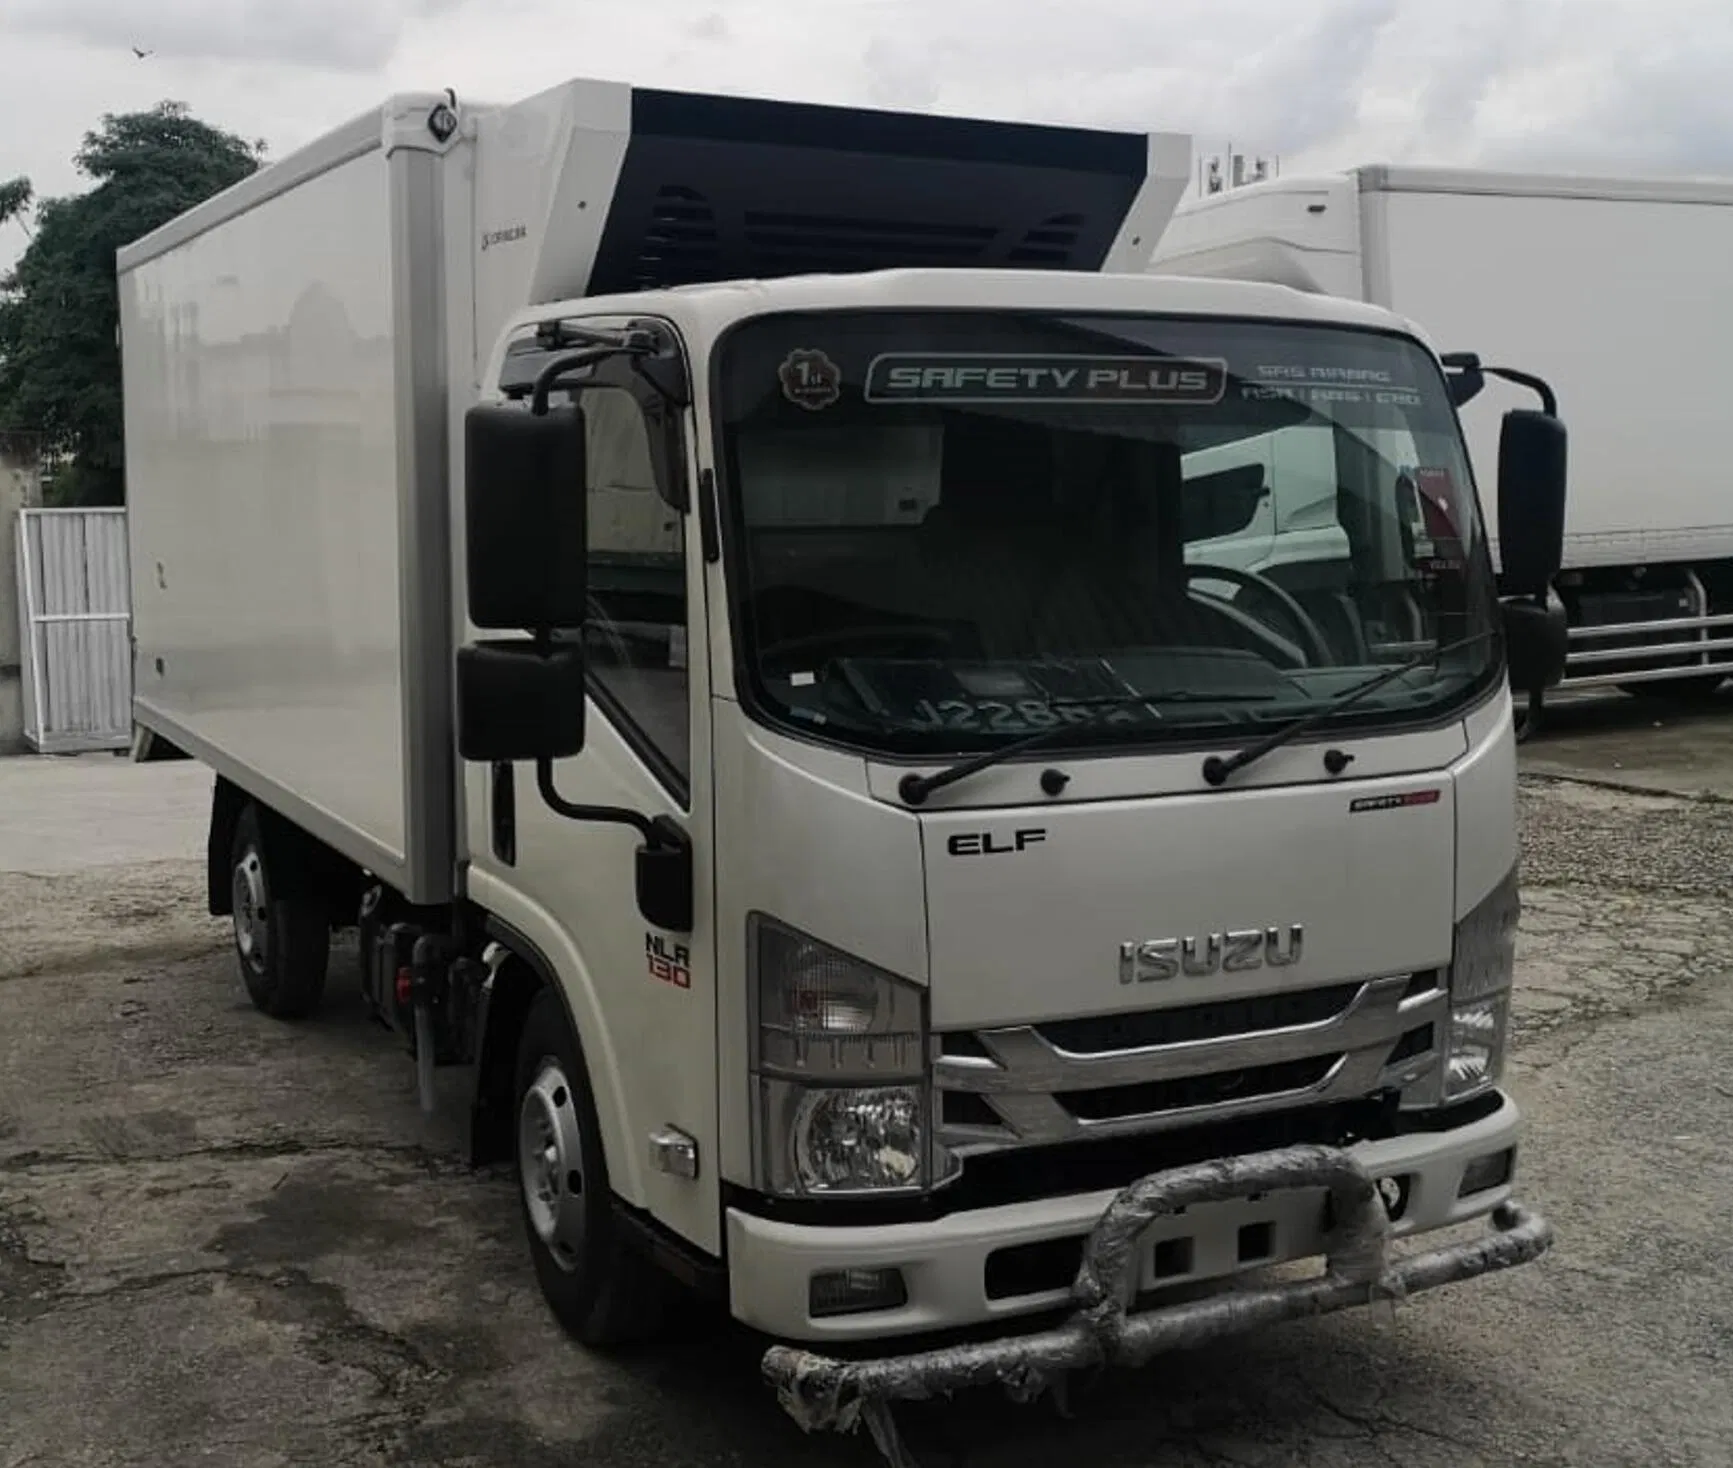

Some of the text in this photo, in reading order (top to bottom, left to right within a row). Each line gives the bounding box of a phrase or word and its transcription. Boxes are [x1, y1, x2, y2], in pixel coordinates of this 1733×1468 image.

[888, 367, 1209, 392] SAFETY PLUS
[947, 828, 1047, 856] ELF
[646, 932, 690, 968] NLR
[1118, 922, 1304, 986] ISUZU
[646, 953, 691, 989] 130
